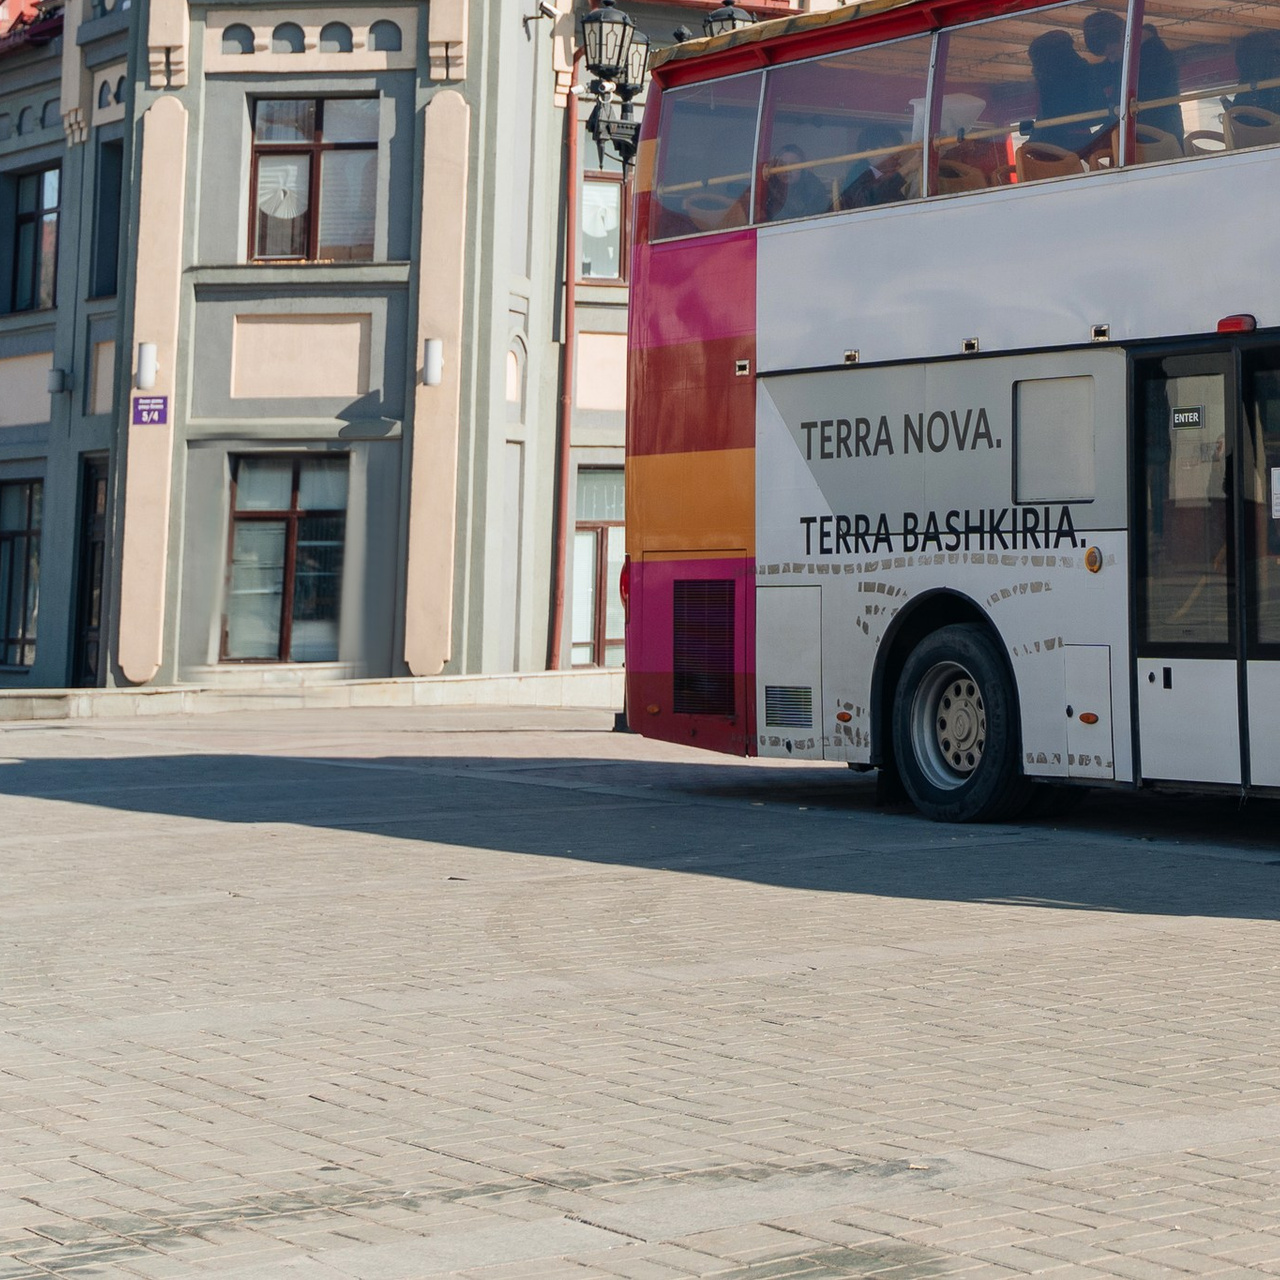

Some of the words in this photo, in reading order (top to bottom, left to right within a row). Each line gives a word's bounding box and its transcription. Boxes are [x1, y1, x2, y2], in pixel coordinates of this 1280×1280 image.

[142, 411, 159, 423] 5/4
[1174, 412, 1199, 423] ENTER
[801, 415, 894, 460] TERRA
[904, 408, 1002, 454] NOVA.
[800, 513, 893, 555] TERRA
[903, 506, 1086, 552] BASHKIRIA.
